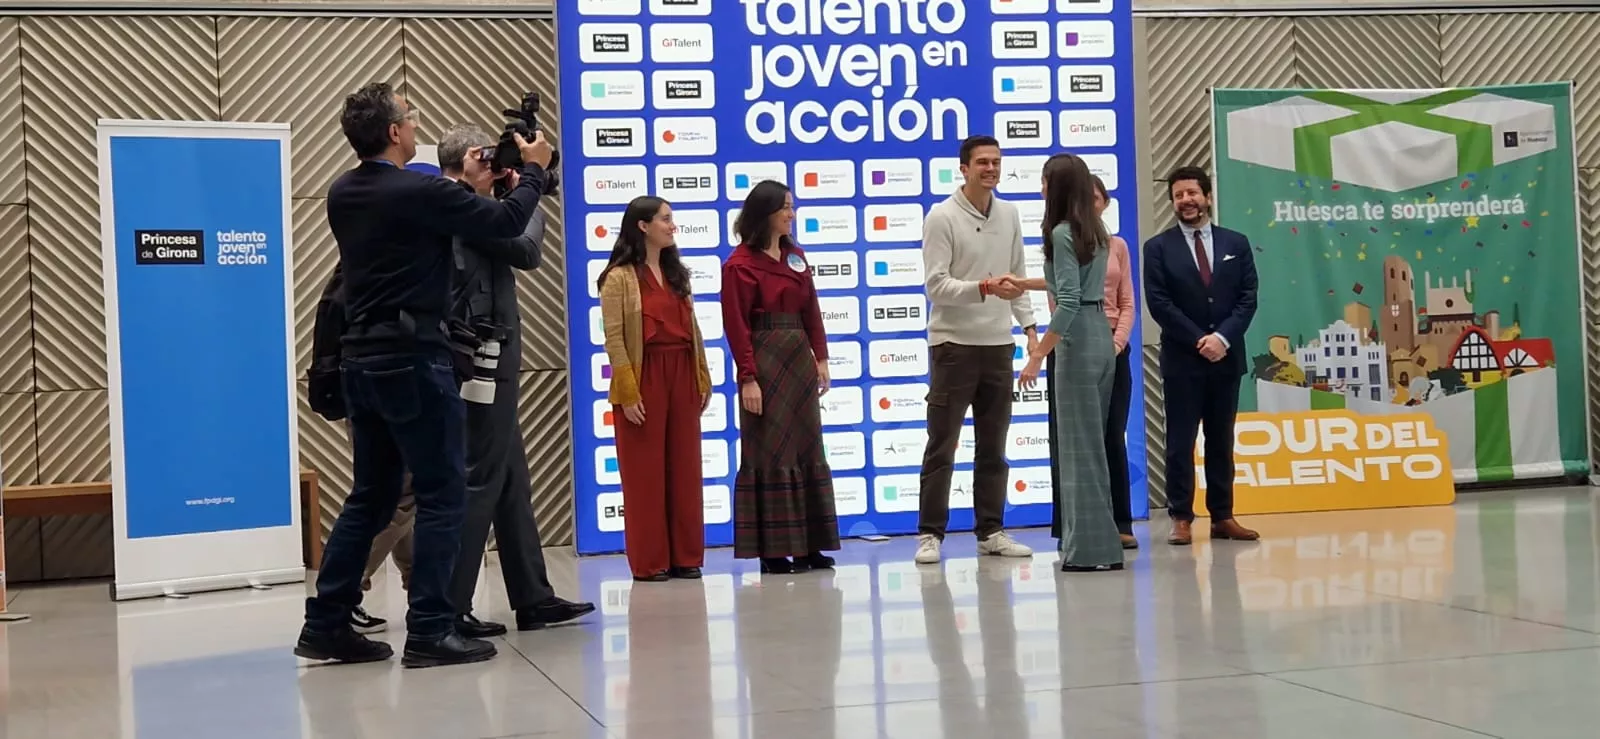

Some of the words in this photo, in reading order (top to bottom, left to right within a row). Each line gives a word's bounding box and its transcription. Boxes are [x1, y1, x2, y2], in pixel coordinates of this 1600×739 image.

[740, 0, 966, 36] talento
[662, 38, 701, 48] GiTalent
[744, 43, 919, 102] joven
[921, 41, 968, 67] en
[744, 85, 968, 144] acción
[1069, 124, 1106, 133] GiTalent
[606, 136, 629, 144] Girona
[595, 180, 636, 190] GiTalent
[1273, 201, 1358, 222] Huesca
[1362, 201, 1385, 221] te
[1391, 193, 1526, 223] sorprenderá
[141, 233, 197, 245] Princesa
[216, 230, 267, 243] talento
[155, 246, 198, 259] Girona
[216, 241, 256, 256] joven
[217, 253, 268, 265] acción
[879, 353, 918, 364] GiTalent
[1195, 417, 1359, 457] OUR
[1365, 421, 1440, 449] DEL
